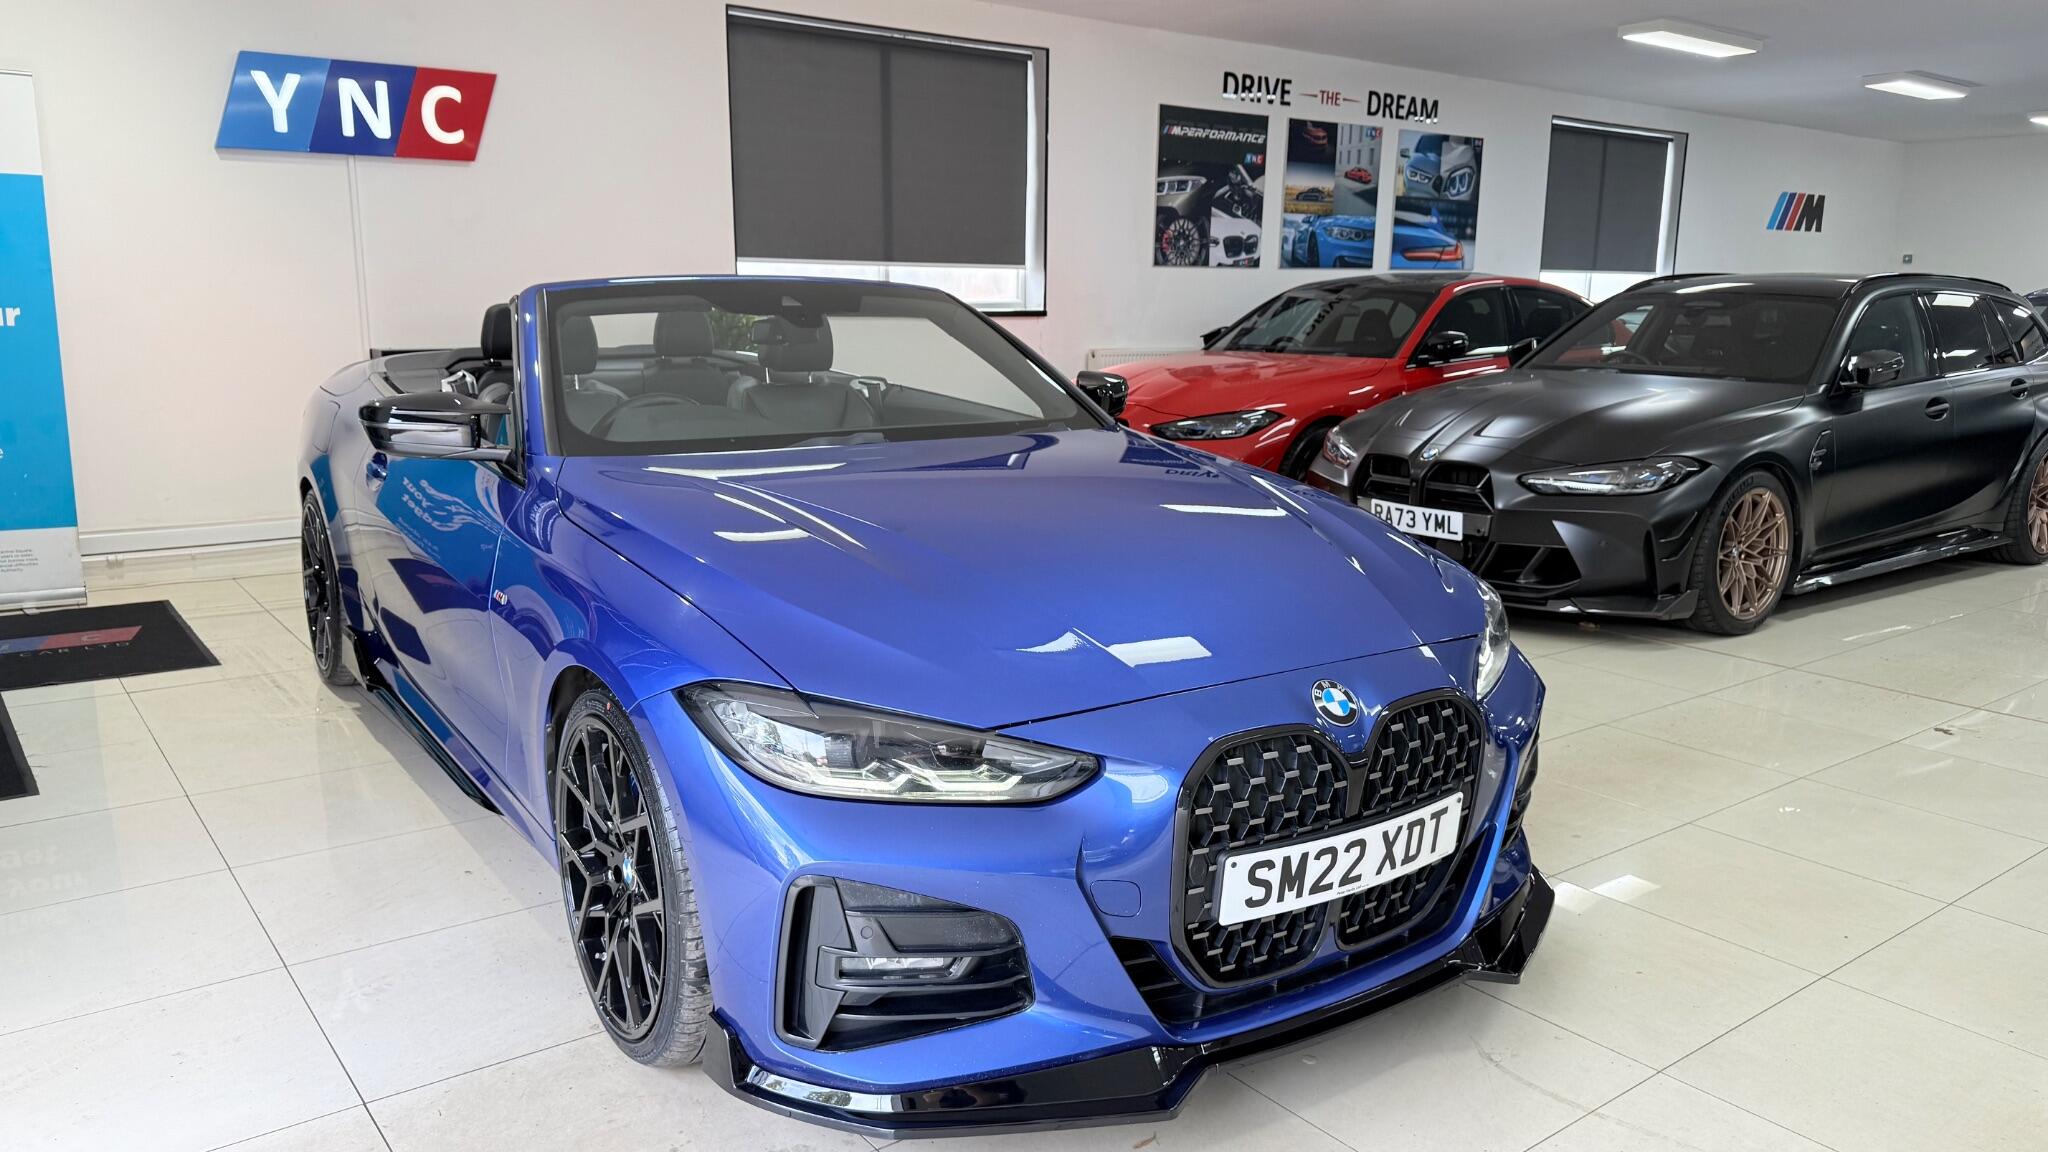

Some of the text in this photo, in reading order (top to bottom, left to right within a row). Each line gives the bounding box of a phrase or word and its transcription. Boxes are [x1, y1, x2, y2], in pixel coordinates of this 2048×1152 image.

[250, 70, 465, 144] YNC
[1222, 71, 1439, 124] DRIVE THE DREAM
[1422, 511, 1458, 535] YML
[1245, 806, 1449, 908] SM22 XDT
